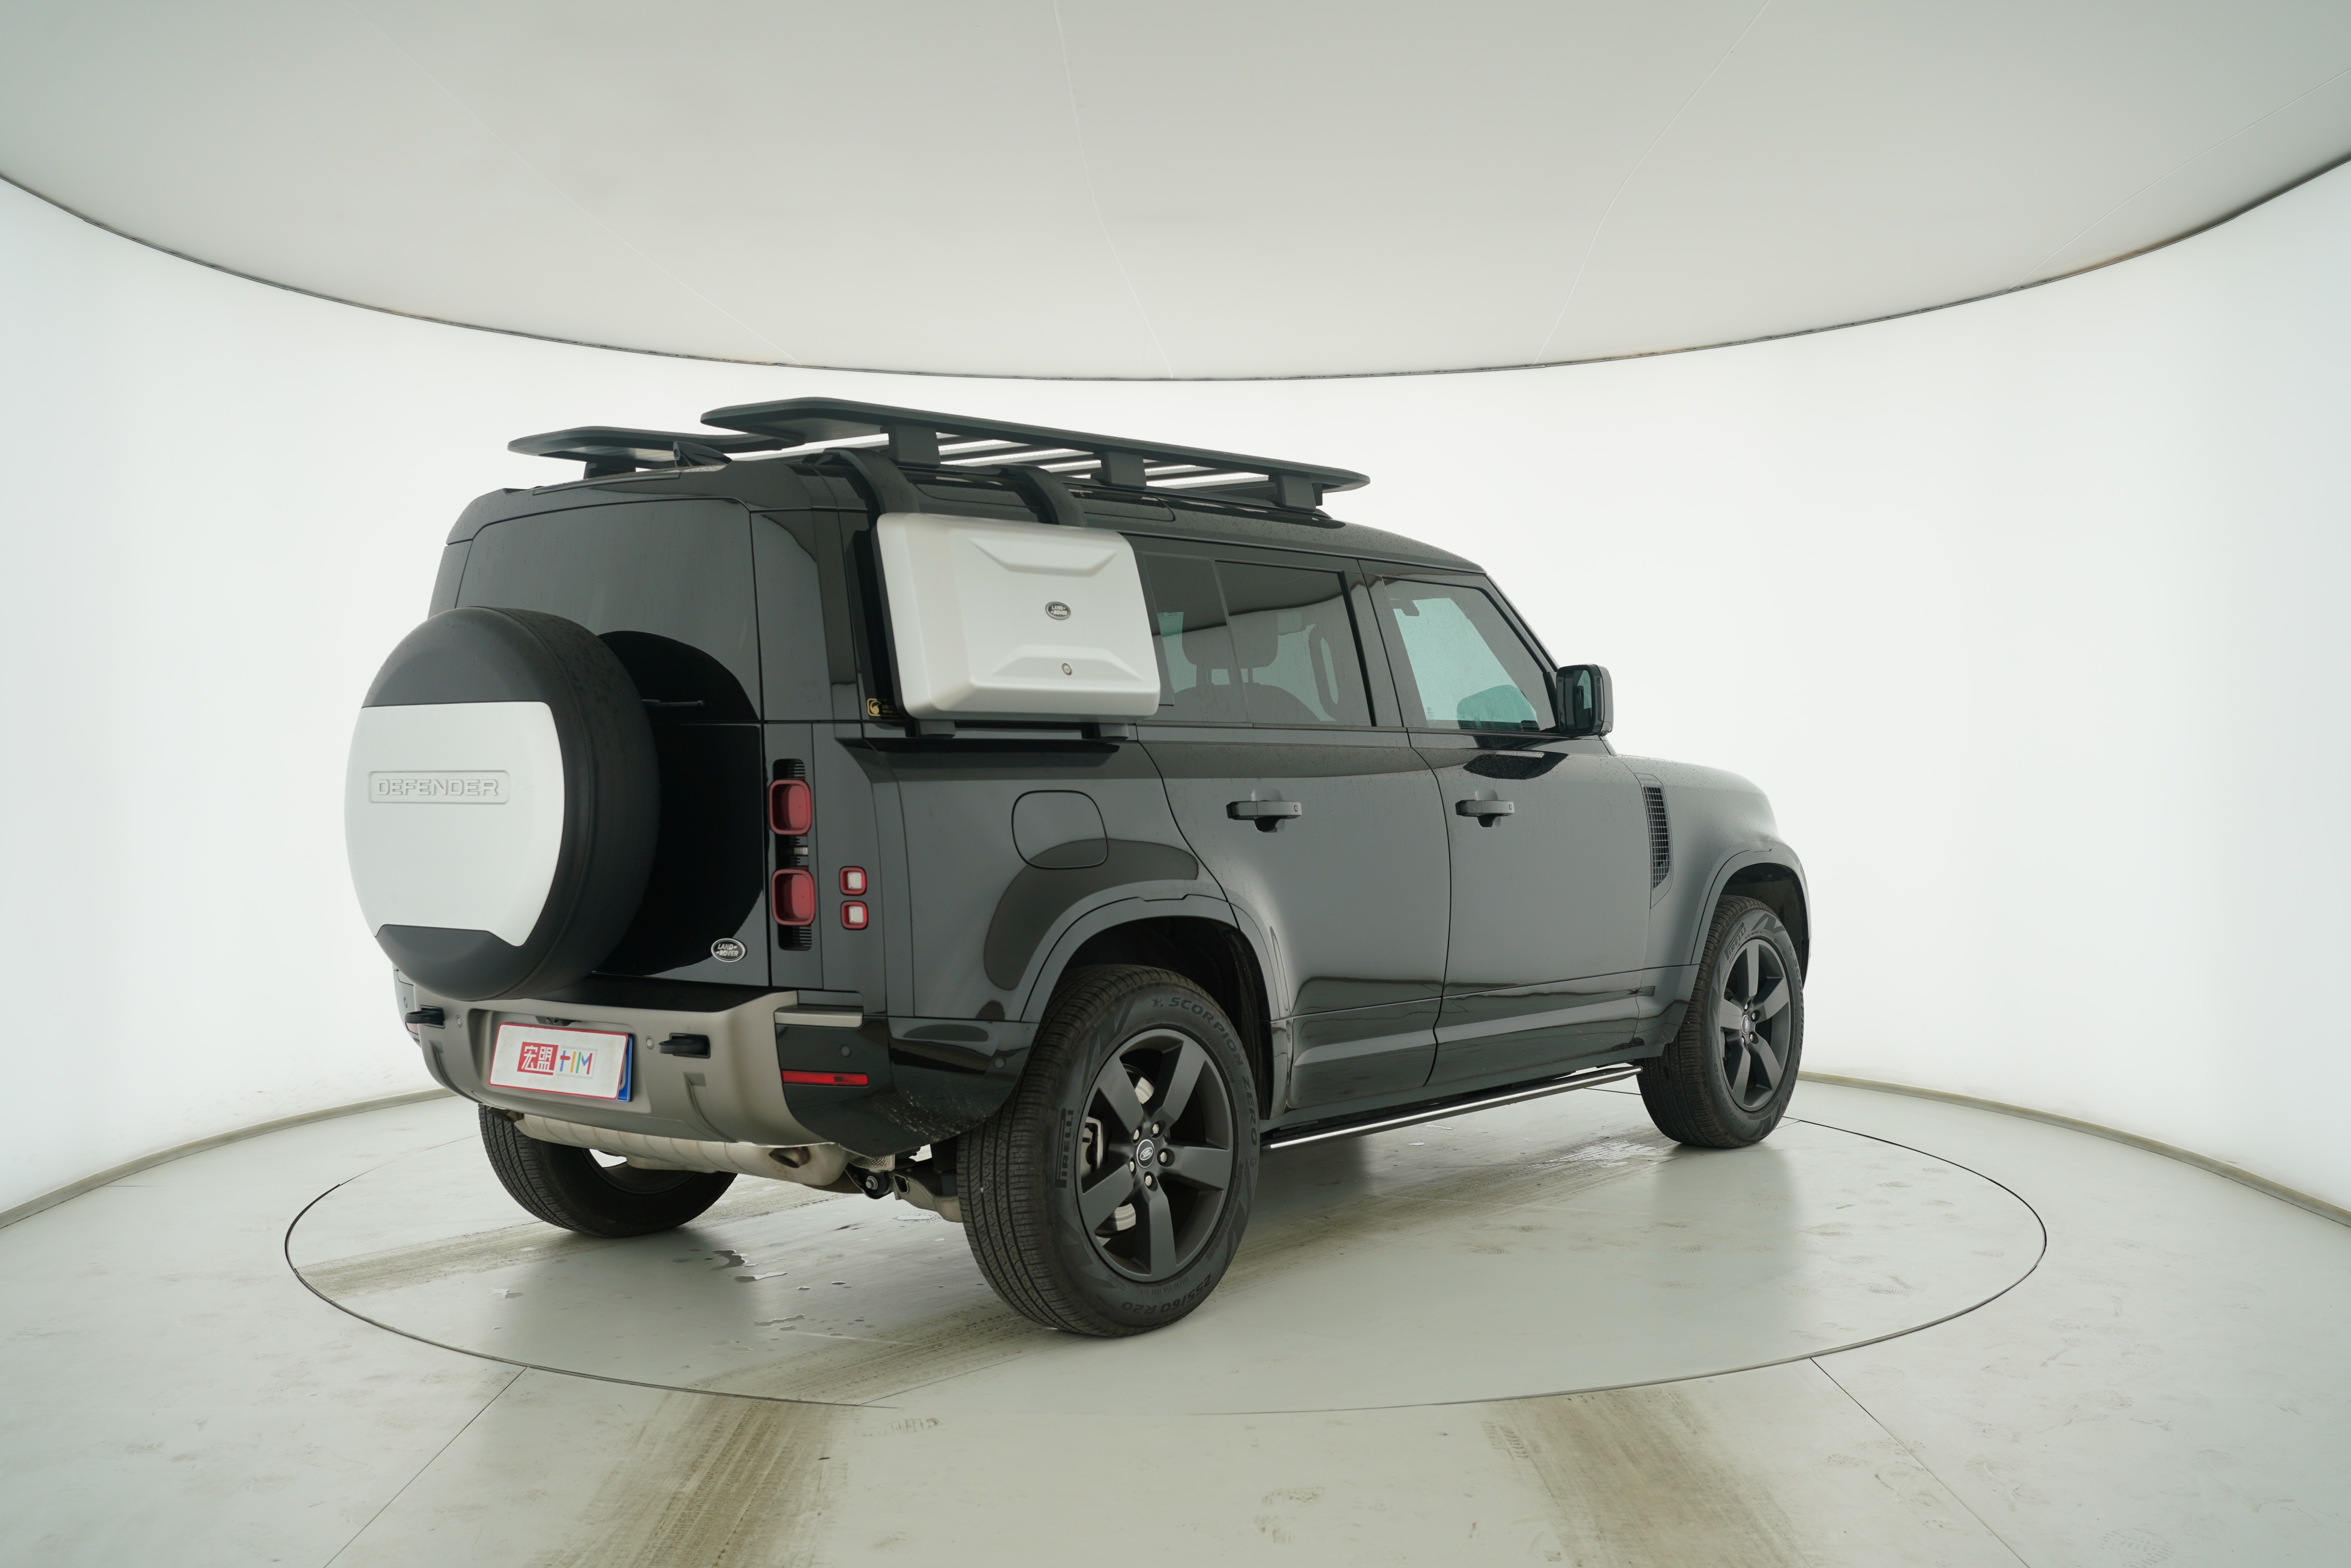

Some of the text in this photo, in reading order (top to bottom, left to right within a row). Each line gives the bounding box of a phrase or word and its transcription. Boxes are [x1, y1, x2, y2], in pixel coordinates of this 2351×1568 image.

[377, 779, 499, 796] DEFENDER
[1724, 922, 1746, 961] PIRELLI
[521, 1045, 554, 1072] 宏盟
[1168, 997, 1257, 1146] SCORPION ZERO
[1054, 1108, 1074, 1189] PIRELLI
[1121, 1301, 1157, 1315] R20
[1160, 1273, 1212, 1314] 255/60
